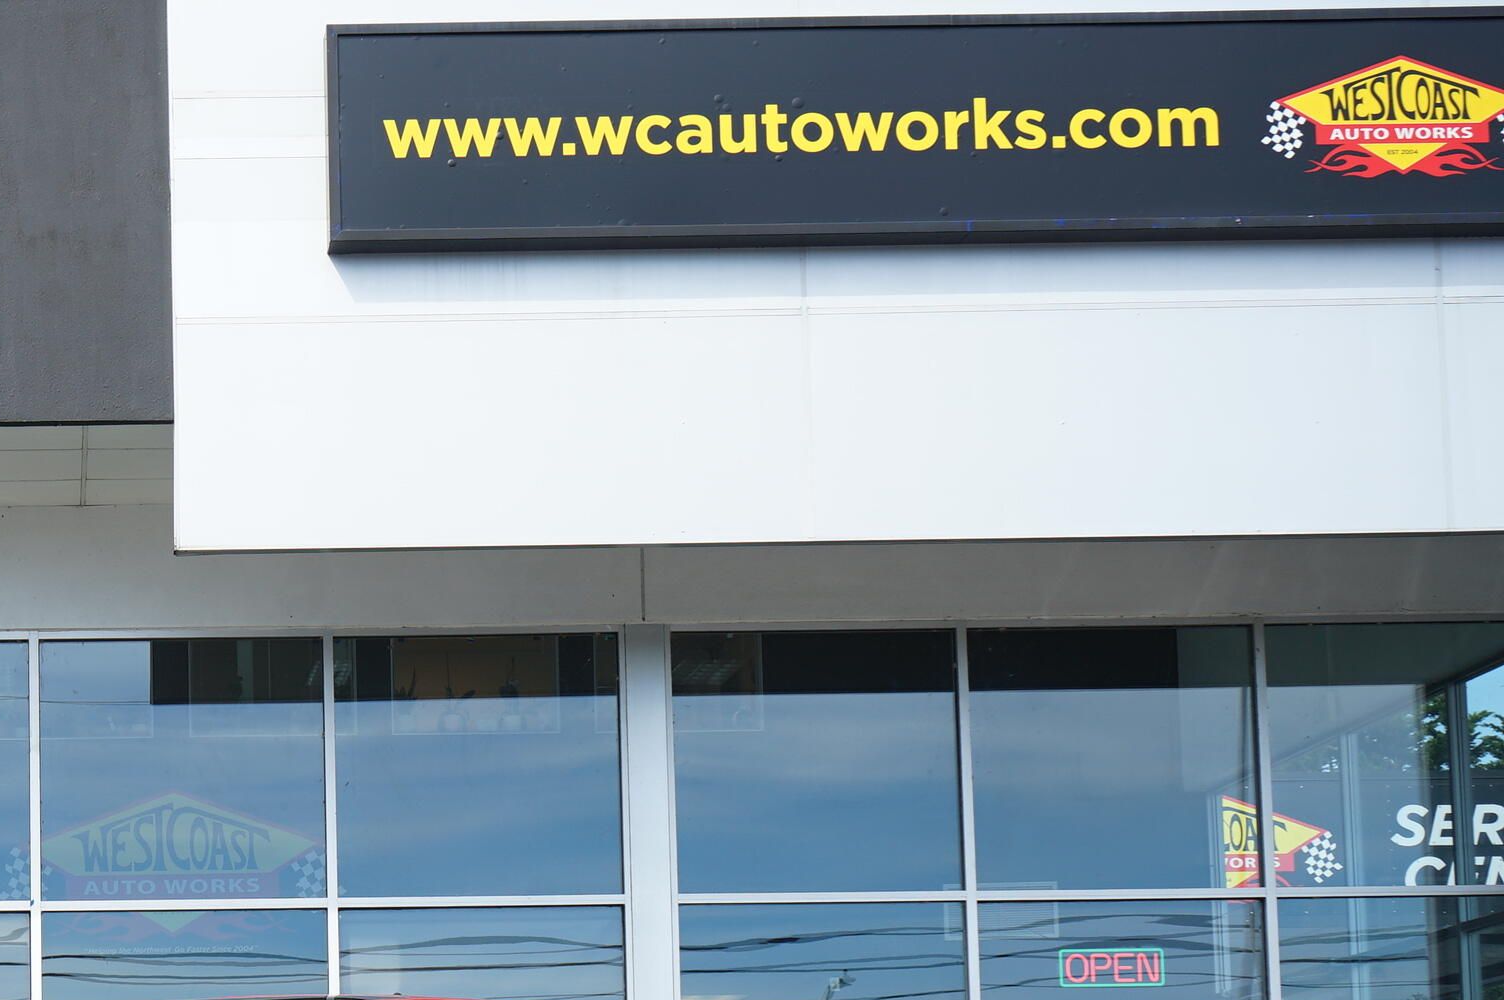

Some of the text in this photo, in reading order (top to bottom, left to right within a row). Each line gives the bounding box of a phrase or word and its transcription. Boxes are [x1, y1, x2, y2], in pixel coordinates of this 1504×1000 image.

[383, 97, 1220, 159] www.wcautoworks.com
[1330, 126, 1473, 140] AUTO WORKS
[84, 876, 262, 896] AUTO WORKS
[1065, 952, 1160, 983] OPEN
